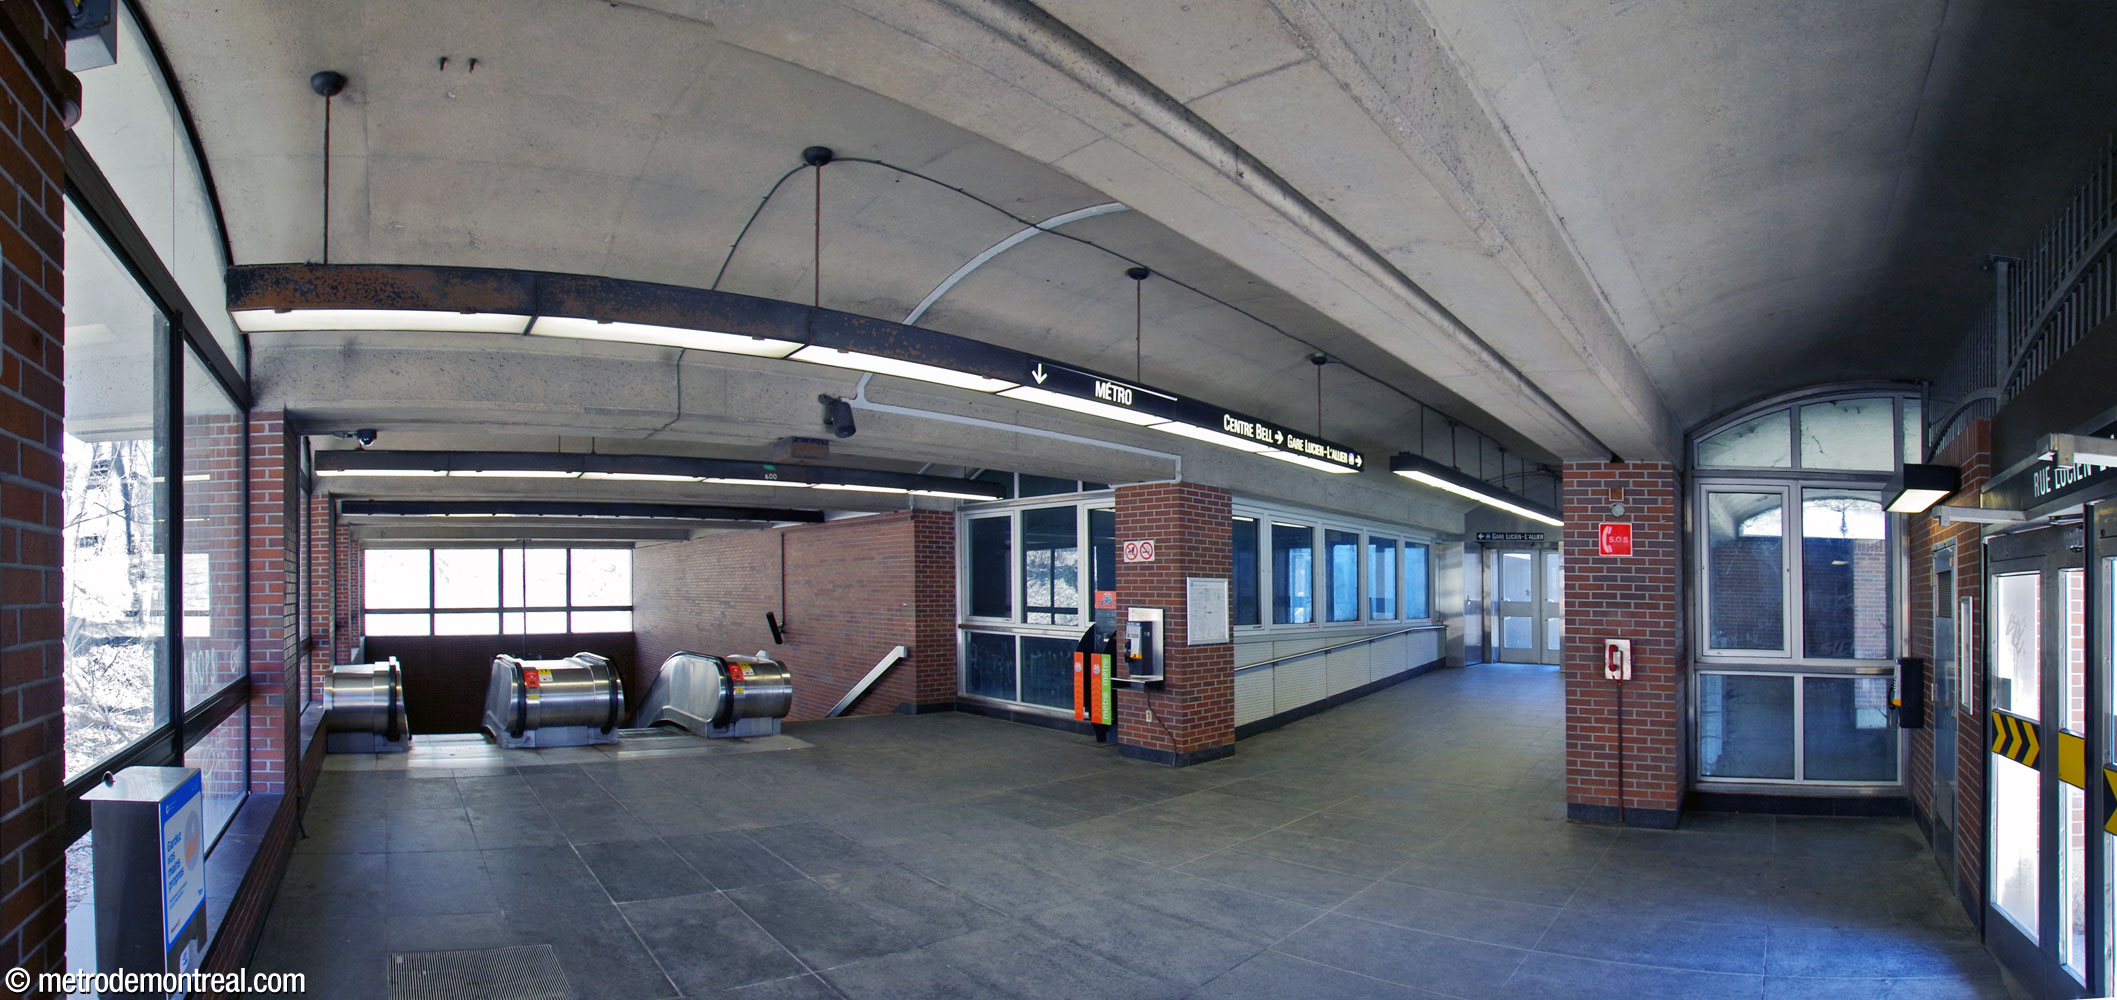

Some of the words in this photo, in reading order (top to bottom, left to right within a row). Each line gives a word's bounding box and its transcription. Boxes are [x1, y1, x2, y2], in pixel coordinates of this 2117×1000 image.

[1095, 380, 1132, 406] MÉTRO
[1223, 413, 1254, 438] CENTRE
[1255, 423, 1274, 443] BELL
[1286, 434, 1304, 452] GARE
[2033, 465, 2052, 498] RUE
[166, 831, 182, 853] Gardez
[167, 851, 176, 865] vos
[167, 858, 181, 878] mains
